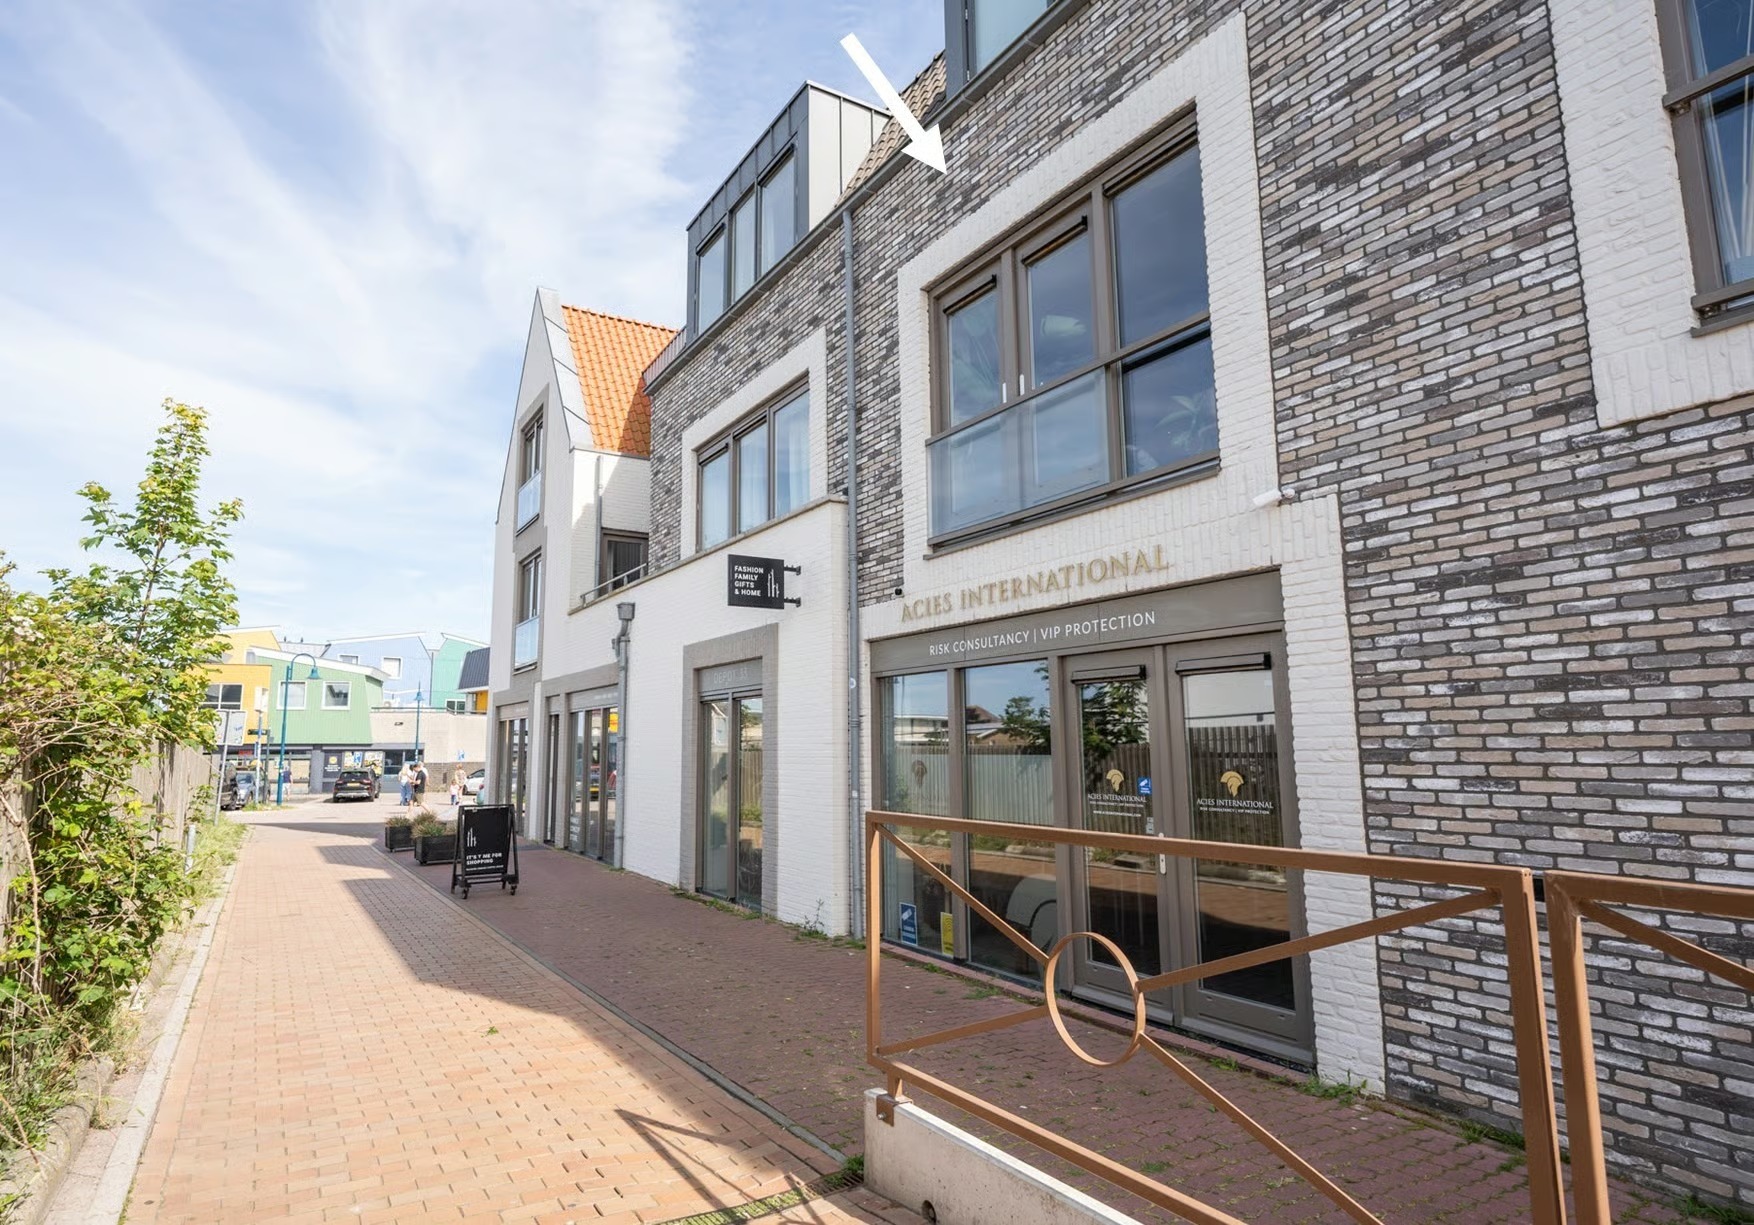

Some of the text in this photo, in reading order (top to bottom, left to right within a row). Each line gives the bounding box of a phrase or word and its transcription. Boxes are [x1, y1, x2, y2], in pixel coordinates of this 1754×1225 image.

[734, 565, 764, 574] FASHION
[901, 544, 1169, 623] ACIES INTERNATIONAL
[741, 589, 761, 597] HOME
[929, 642, 950, 656] RISK
[953, 631, 1030, 653] CONSULTANCY
[1040, 625, 1061, 641] VIP
[1065, 611, 1155, 637] PROTECTION
[1103, 794, 1147, 803] INTERNATIONAL
[1196, 798, 1273, 809] ACIES INTERNATIONAL
